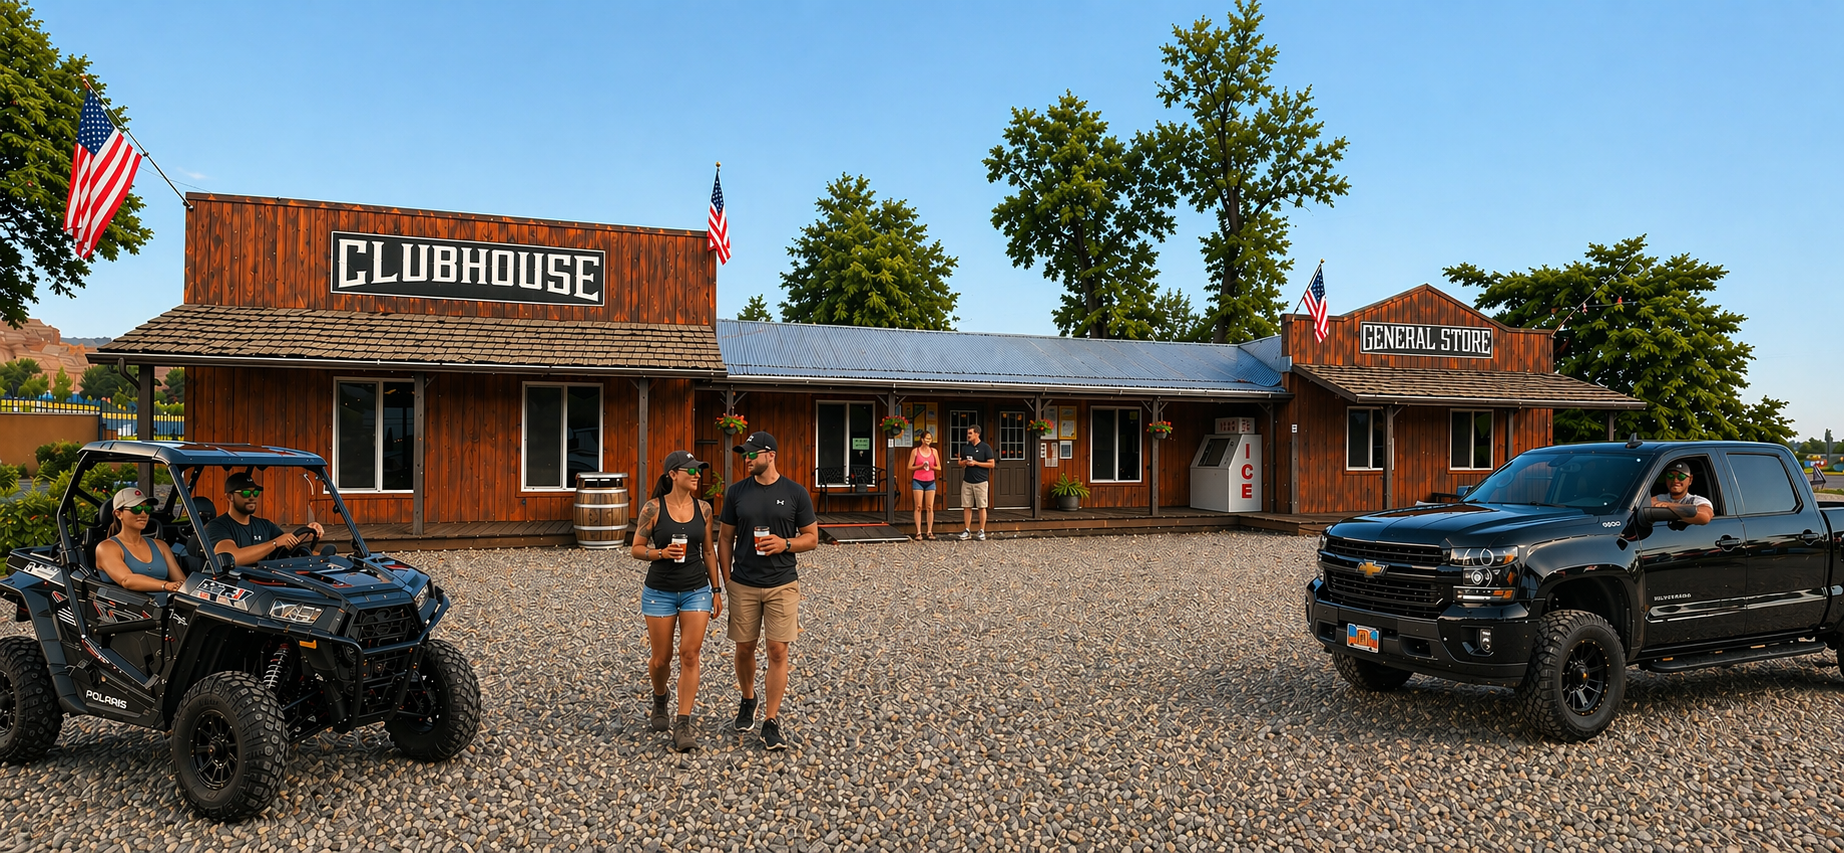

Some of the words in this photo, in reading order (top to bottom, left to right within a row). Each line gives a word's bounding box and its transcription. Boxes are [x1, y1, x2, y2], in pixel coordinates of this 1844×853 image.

[338, 238, 600, 302] CLUBHOUSE
[1363, 324, 1436, 351] GENERAL
[1440, 328, 1491, 354] STORE
[1241, 443, 1254, 499] ICE
[86, 690, 127, 709] POLARIS
